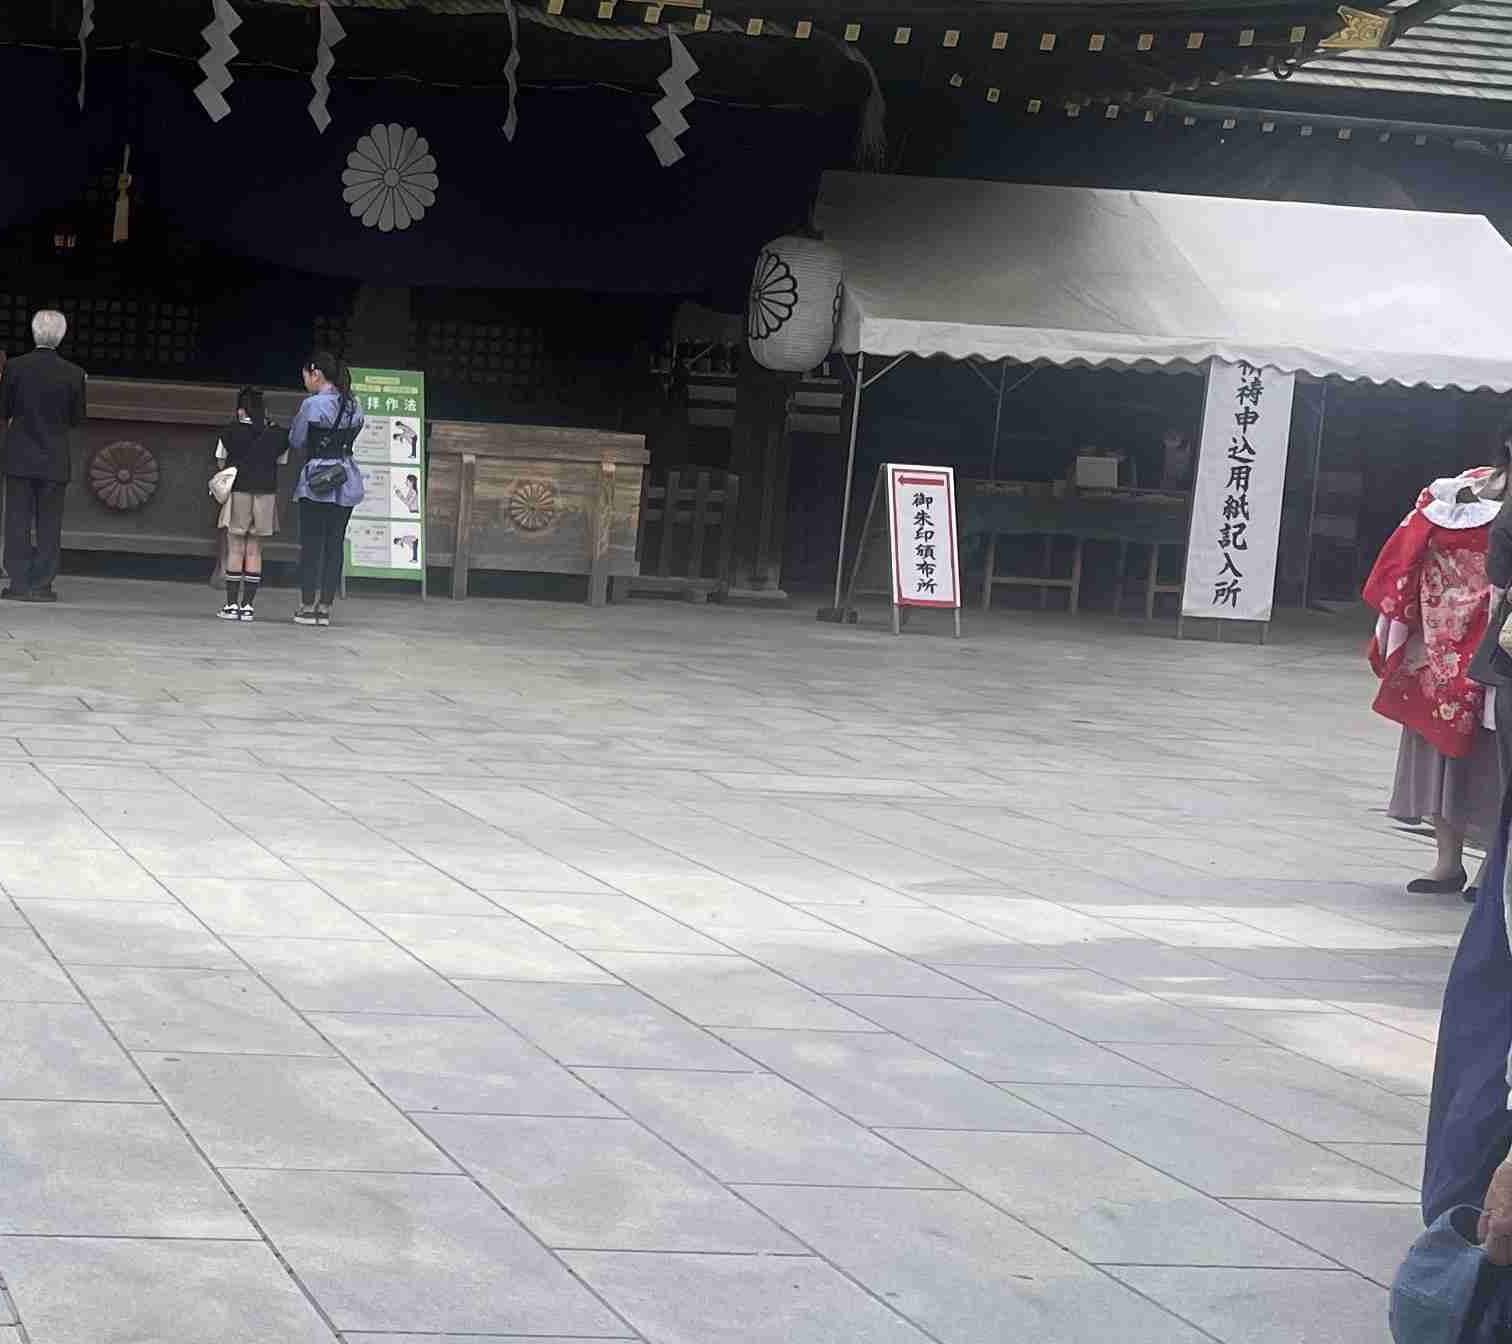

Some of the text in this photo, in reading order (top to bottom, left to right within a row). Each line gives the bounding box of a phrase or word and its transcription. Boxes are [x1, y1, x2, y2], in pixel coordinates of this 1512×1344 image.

[368, 396, 416, 412] 拝作法
[911, 492, 937, 594] 御朱印頒布所
